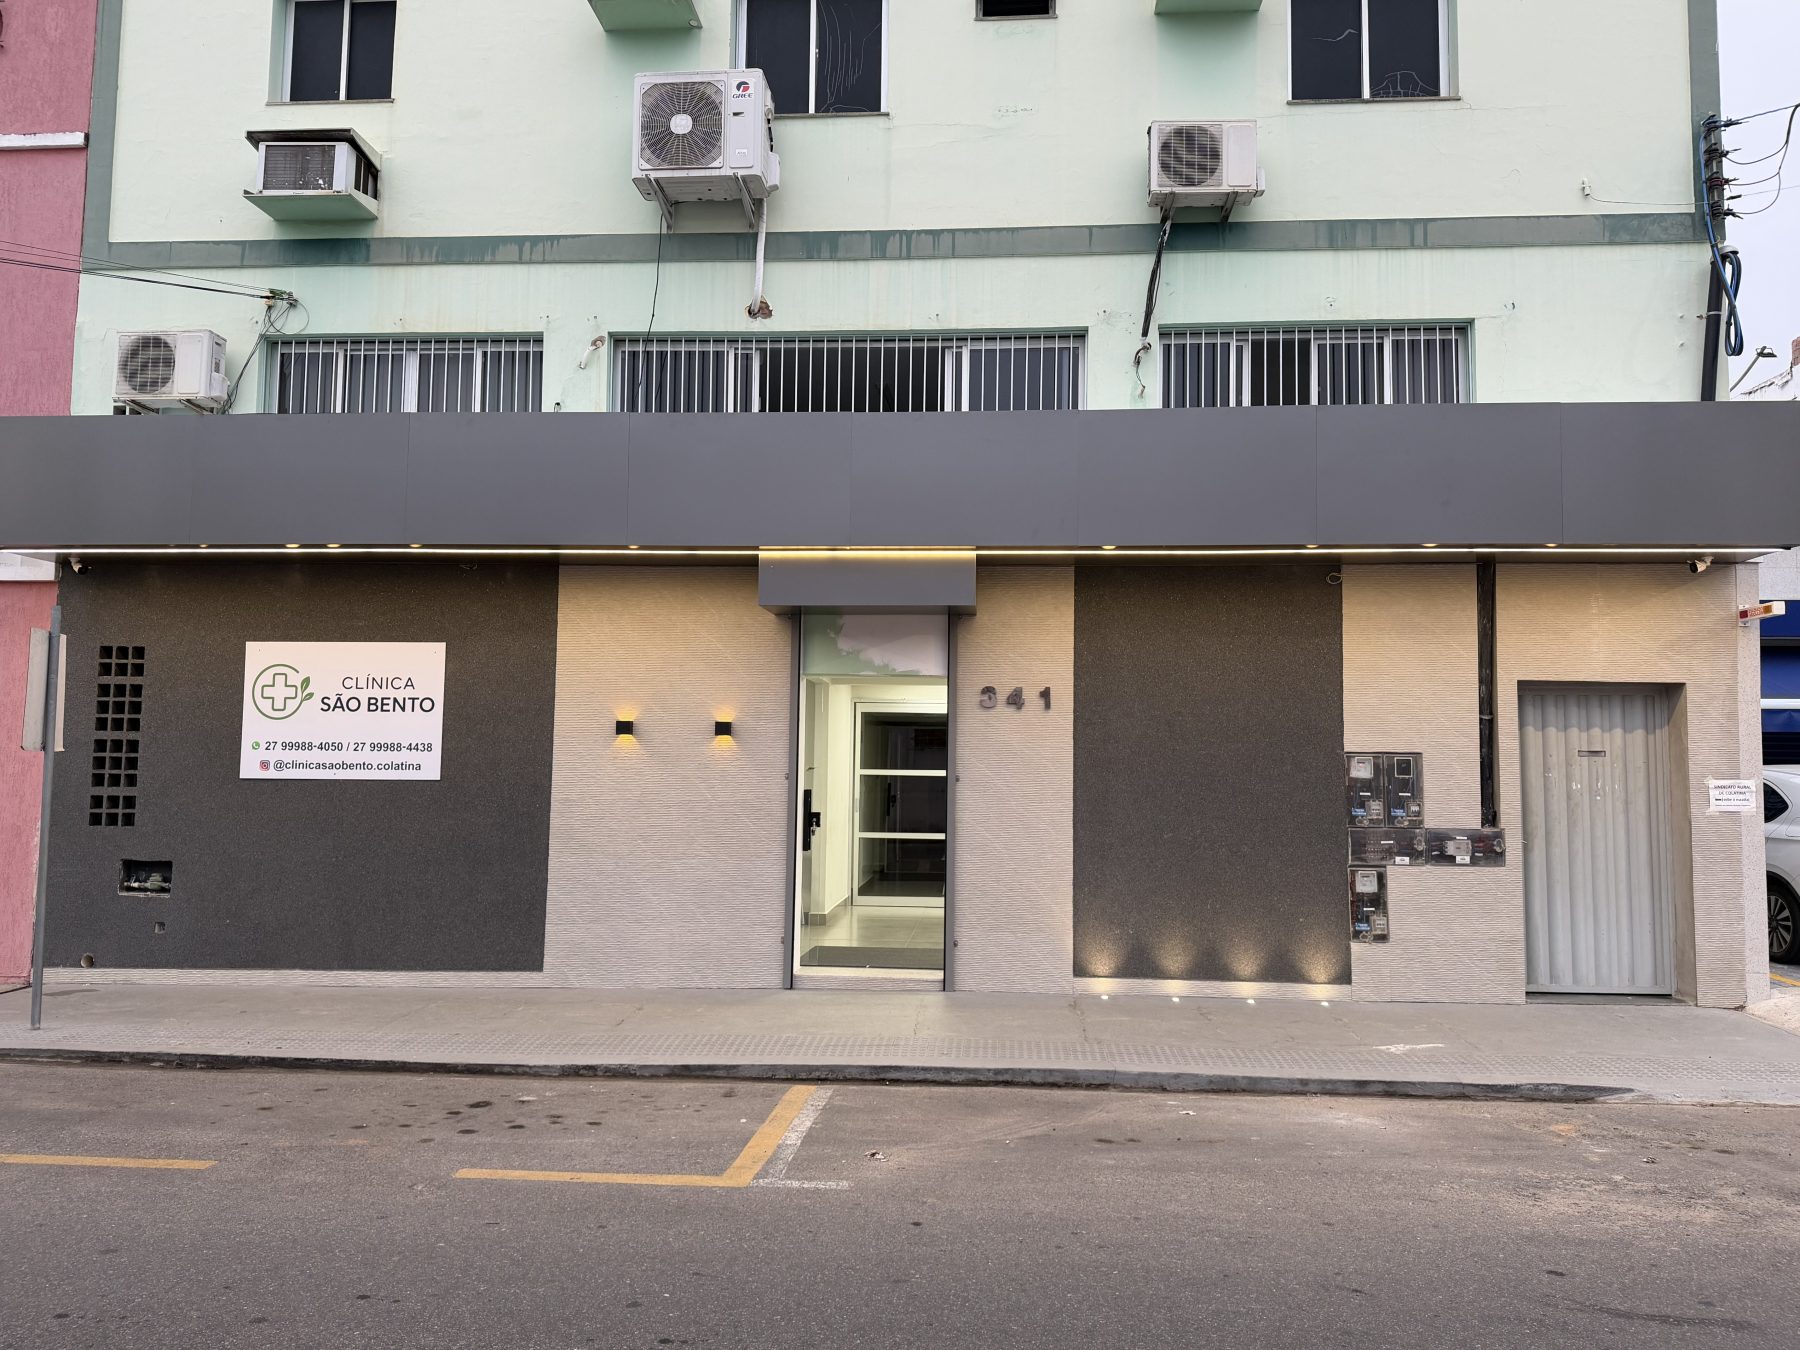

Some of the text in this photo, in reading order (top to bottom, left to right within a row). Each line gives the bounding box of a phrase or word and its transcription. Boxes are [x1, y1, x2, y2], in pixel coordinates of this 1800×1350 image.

[342, 674, 416, 690] CLÍNICA
[320, 694, 435, 713] SÃO BENTO
[980, 686, 1051, 710] 341
[264, 742, 432, 752] 27 99988-4050 / 27 99988-4438
[273, 760, 421, 772] @clinicasaobento.colatina
